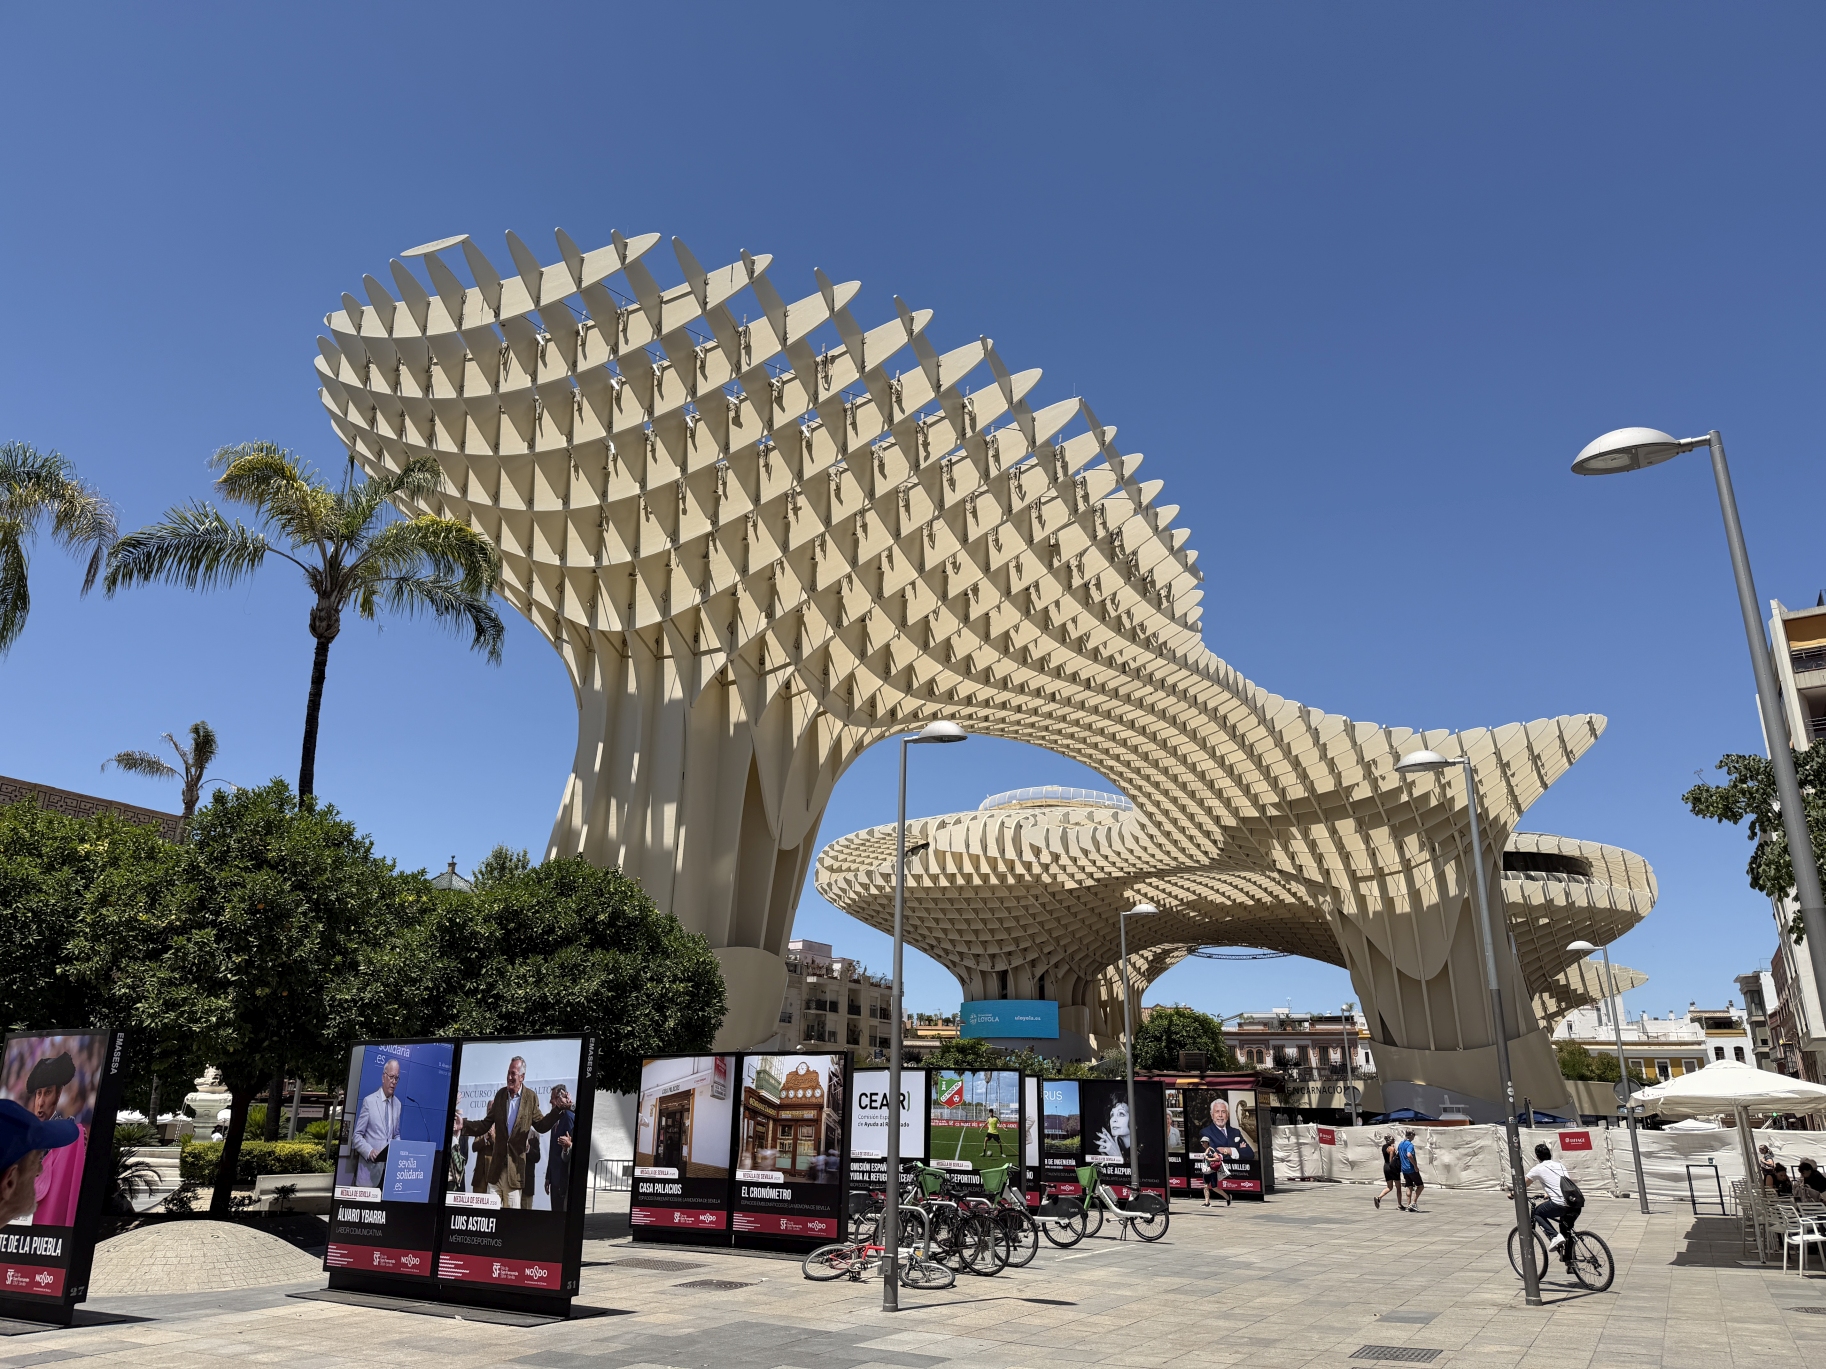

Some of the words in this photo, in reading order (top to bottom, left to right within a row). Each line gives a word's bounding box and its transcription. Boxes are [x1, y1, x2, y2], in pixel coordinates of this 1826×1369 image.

[110, 1032, 124, 1075] EMASESA
[586, 1037, 595, 1079] EMASESA
[531, 1085, 552, 1095] ALTO
[398, 1158, 417, 1168] sevilla
[396, 1169, 424, 1180] solidaria
[863, 1172, 870, 1181] AL
[359, 1190, 371, 1198] SEVILLA
[639, 1182, 653, 1194] CASA
[654, 1183, 682, 1195] PALACIOS
[741, 1186, 749, 1198] EL
[749, 1185, 792, 1200] CRONÓMETRO
[453, 1195, 470, 1203] MEDALLA
[470, 1196, 475, 1204] DE
[475, 1197, 489, 1205] SEVILLA
[337, 1204, 360, 1222] ÁLVARO
[361, 1209, 386, 1225] YBARRA
[450, 1214, 467, 1230] LUIS
[467, 1216, 497, 1233] ASTOLFI
[335, 1226, 350, 1234] LABOR
[7, 1234, 20, 1253] DE
[19, 1235, 30, 1254] LA
[31, 1236, 63, 1257] PUEBLA
[449, 1234, 471, 1244] MÉRITOS
[471, 1236, 502, 1247] DEPORTIVOS
[69, 1285, 85, 1297] 27
